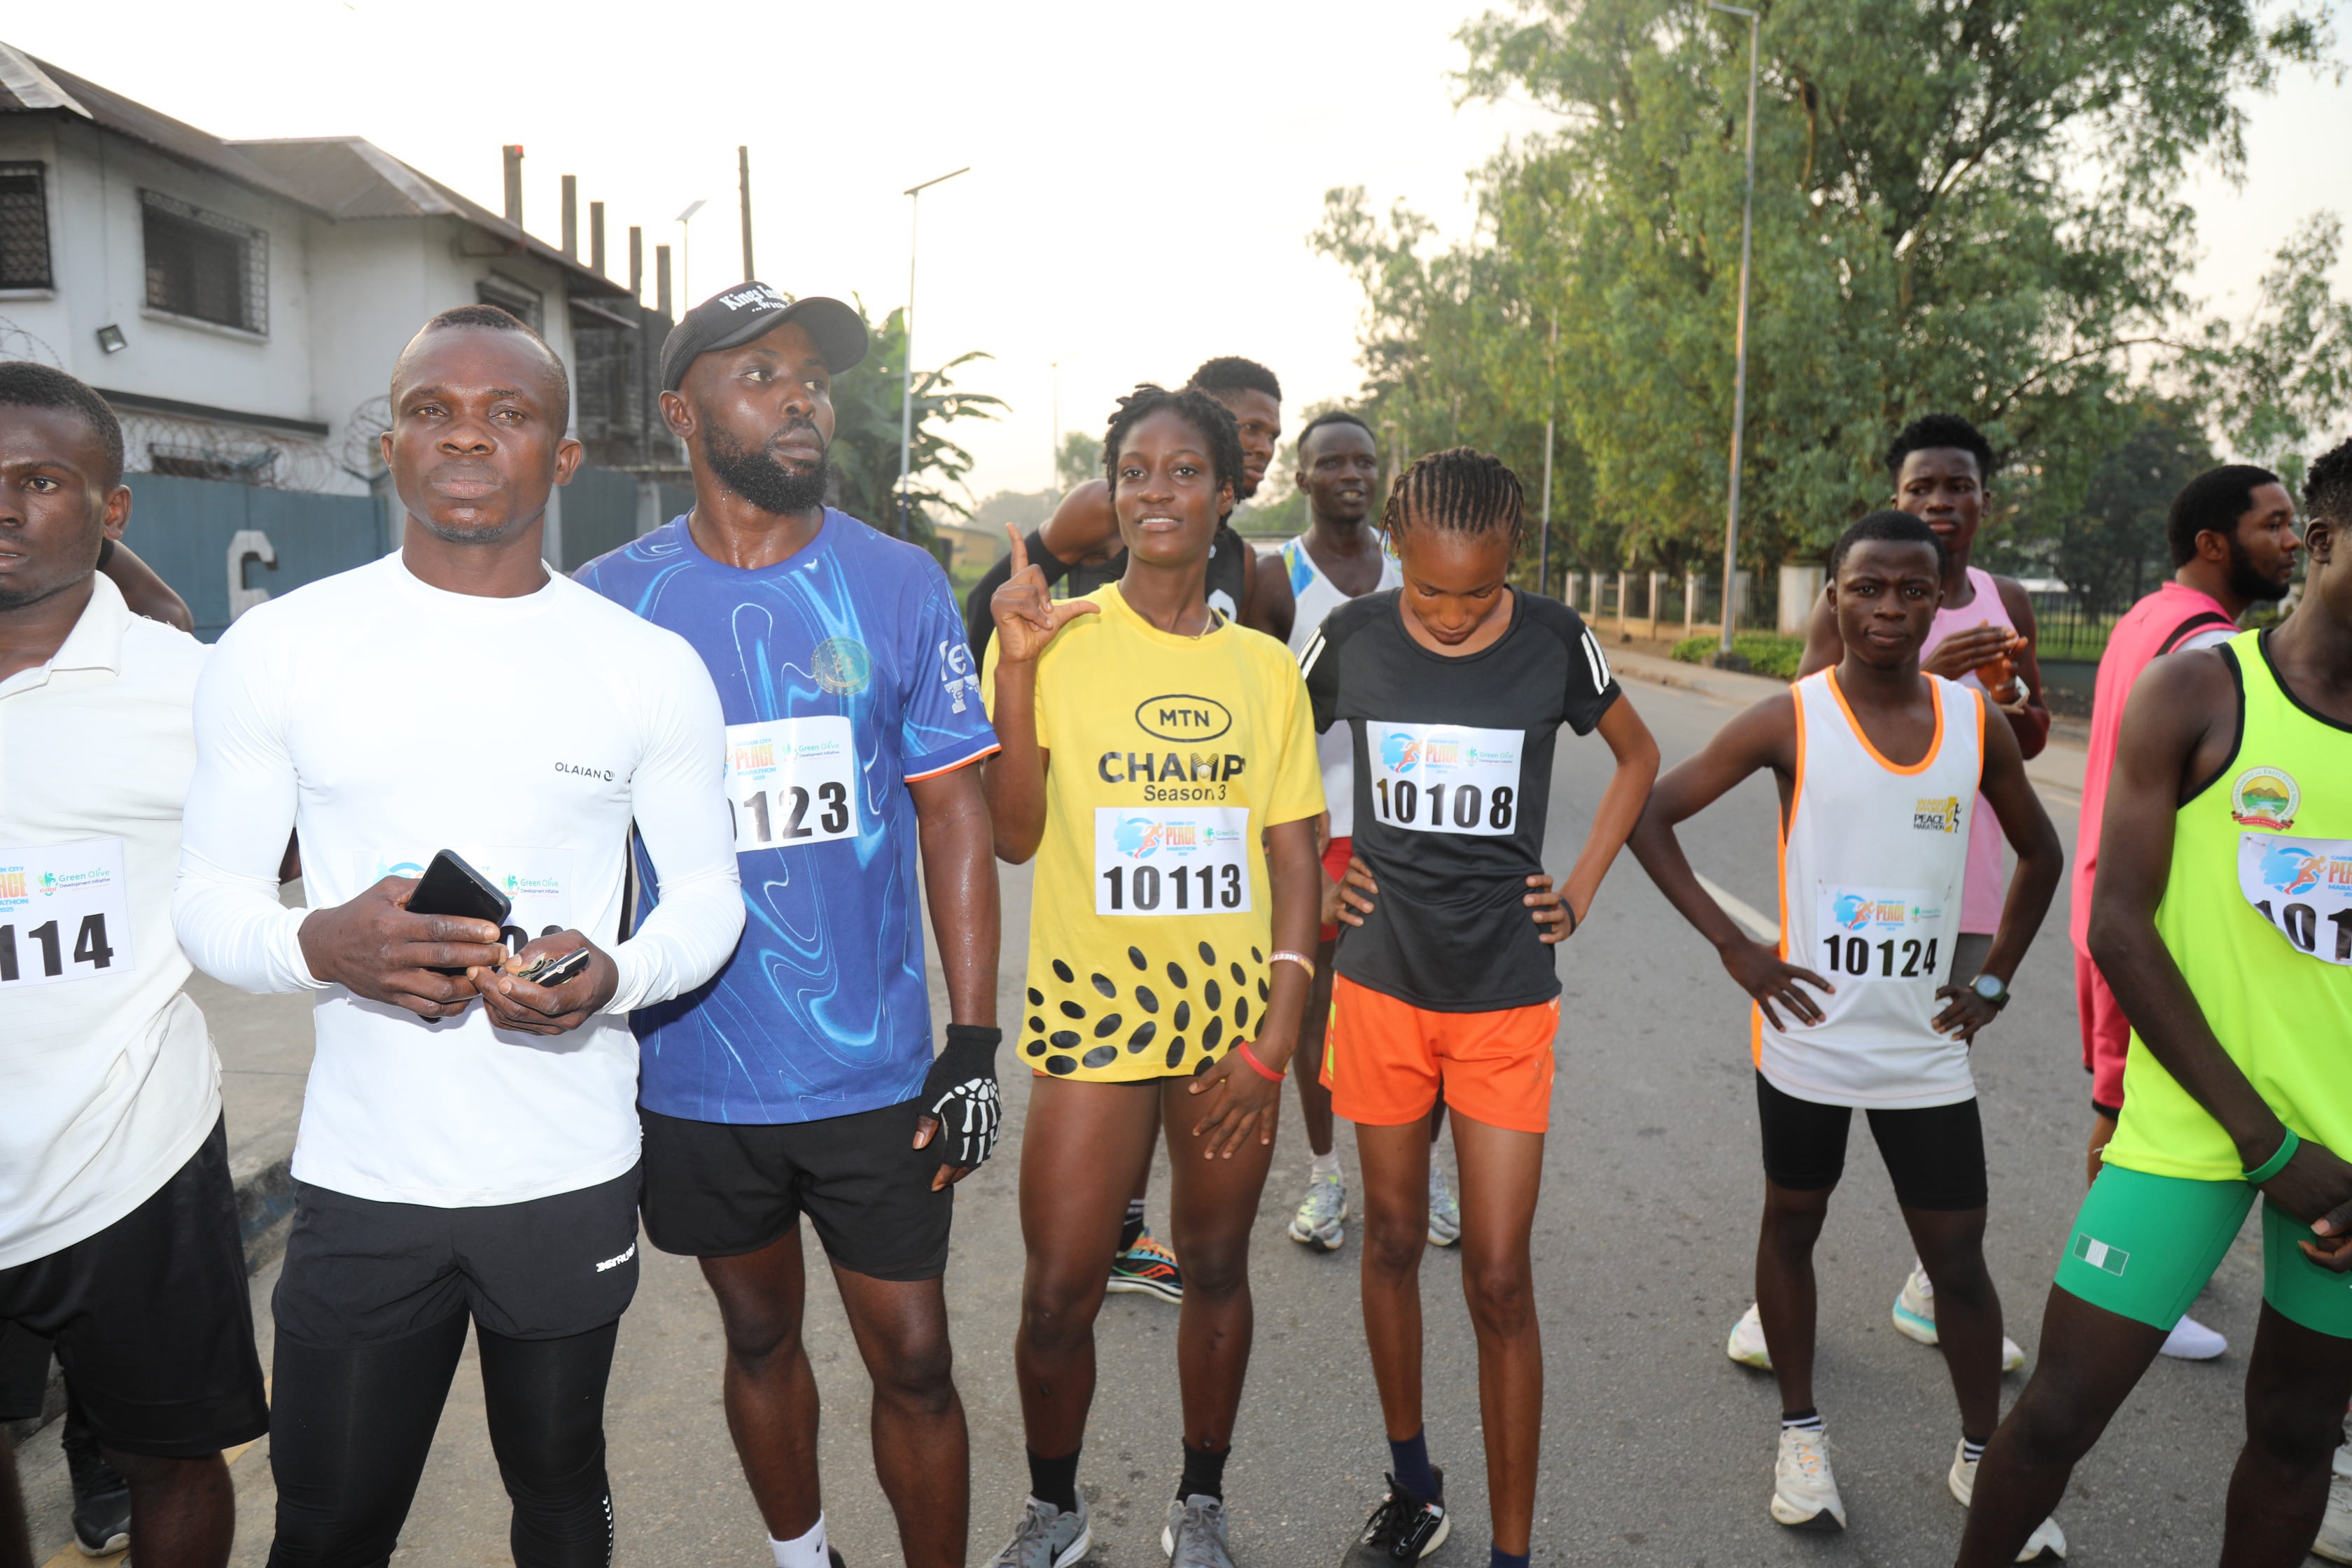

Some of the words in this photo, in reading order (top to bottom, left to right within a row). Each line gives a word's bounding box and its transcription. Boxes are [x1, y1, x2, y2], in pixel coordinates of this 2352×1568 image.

[1159, 709, 1210, 727] MTN
[821, 741, 839, 749] Olive
[735, 744, 775, 770] PEACE
[555, 762, 601, 779] OLAIAN
[737, 767, 776, 776] MARATHON
[1098, 752, 1245, 783] CHAMP
[1144, 785, 1215, 802] Season
[1218, 784, 1226, 801] 3
[727, 782, 849, 843] 123
[1377, 778, 1513, 830] 10108
[1914, 814, 1944, 824] PEACE
[1166, 827, 1196, 845] PEACE
[59, 873, 86, 882] Green
[88, 867, 110, 878] Olive
[542, 877, 559, 887] Olive
[59, 880, 91, 888] Development
[1103, 863, 1241, 910] 10113
[1877, 905, 1905, 922] PEACE
[1823, 934, 1938, 976] 10124
